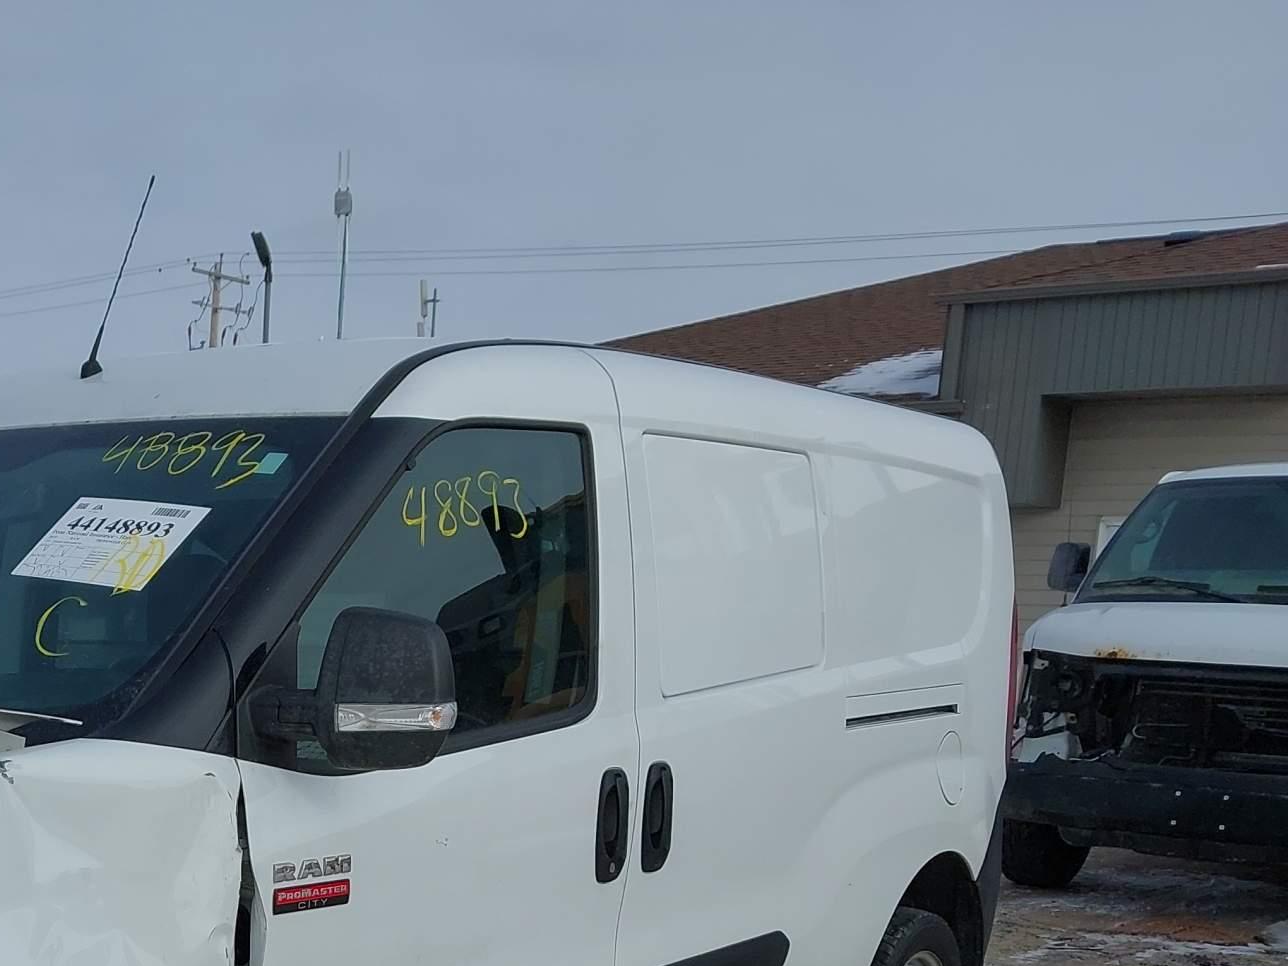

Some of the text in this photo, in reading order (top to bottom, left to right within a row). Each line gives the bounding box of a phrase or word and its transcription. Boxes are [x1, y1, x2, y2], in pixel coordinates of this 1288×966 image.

[102, 429, 265, 489] 48893
[67, 516, 176, 538] 44148893
[402, 470, 528, 547] 48893
[35, 596, 88, 657] C
[272, 854, 352, 884] RAM
[297, 898, 328, 910] CITY
